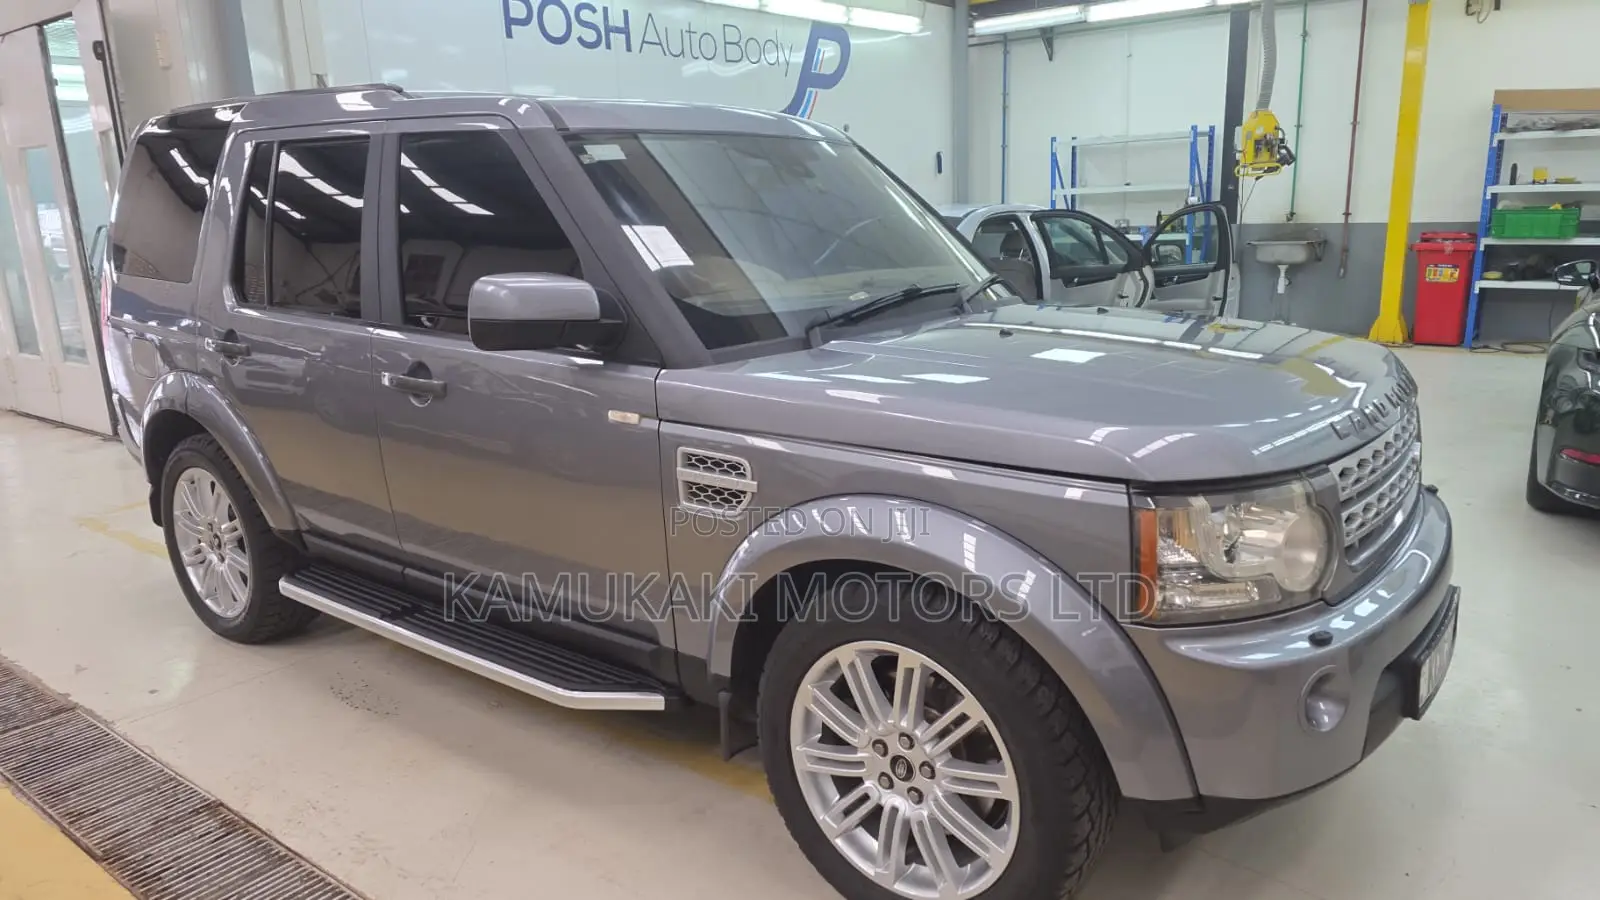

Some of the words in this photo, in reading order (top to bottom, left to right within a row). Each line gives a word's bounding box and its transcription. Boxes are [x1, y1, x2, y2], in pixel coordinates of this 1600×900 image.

[502, 0, 632, 52] POSH
[639, 13, 717, 61] Auto
[723, 24, 793, 77] Body
